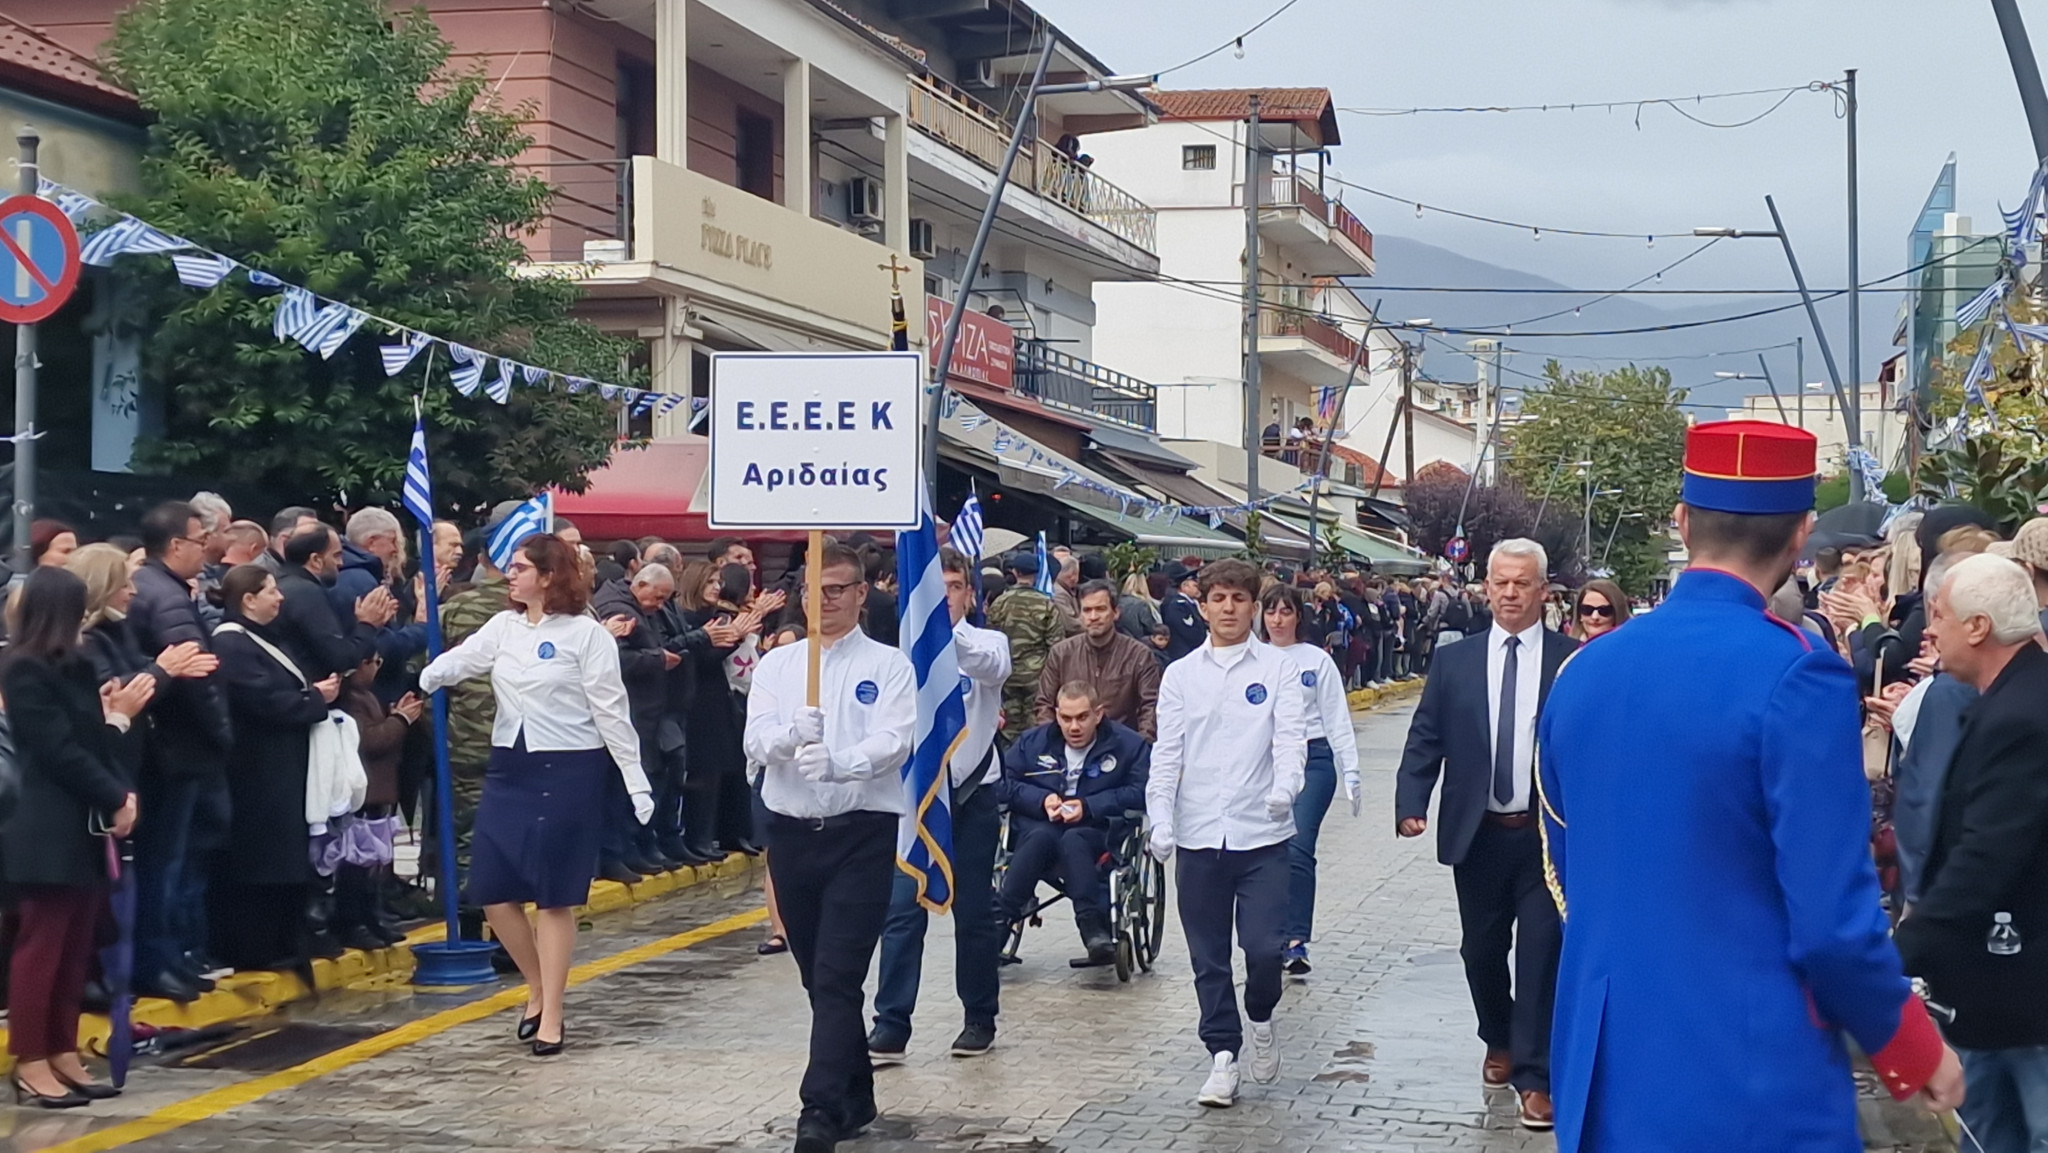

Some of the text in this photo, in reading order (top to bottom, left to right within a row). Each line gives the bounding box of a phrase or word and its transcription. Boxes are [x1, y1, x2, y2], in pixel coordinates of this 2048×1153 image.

[737, 401, 894, 430] Ε.Ε.Ε.Ε Κ
[742, 461, 888, 492] Αριδαίας
